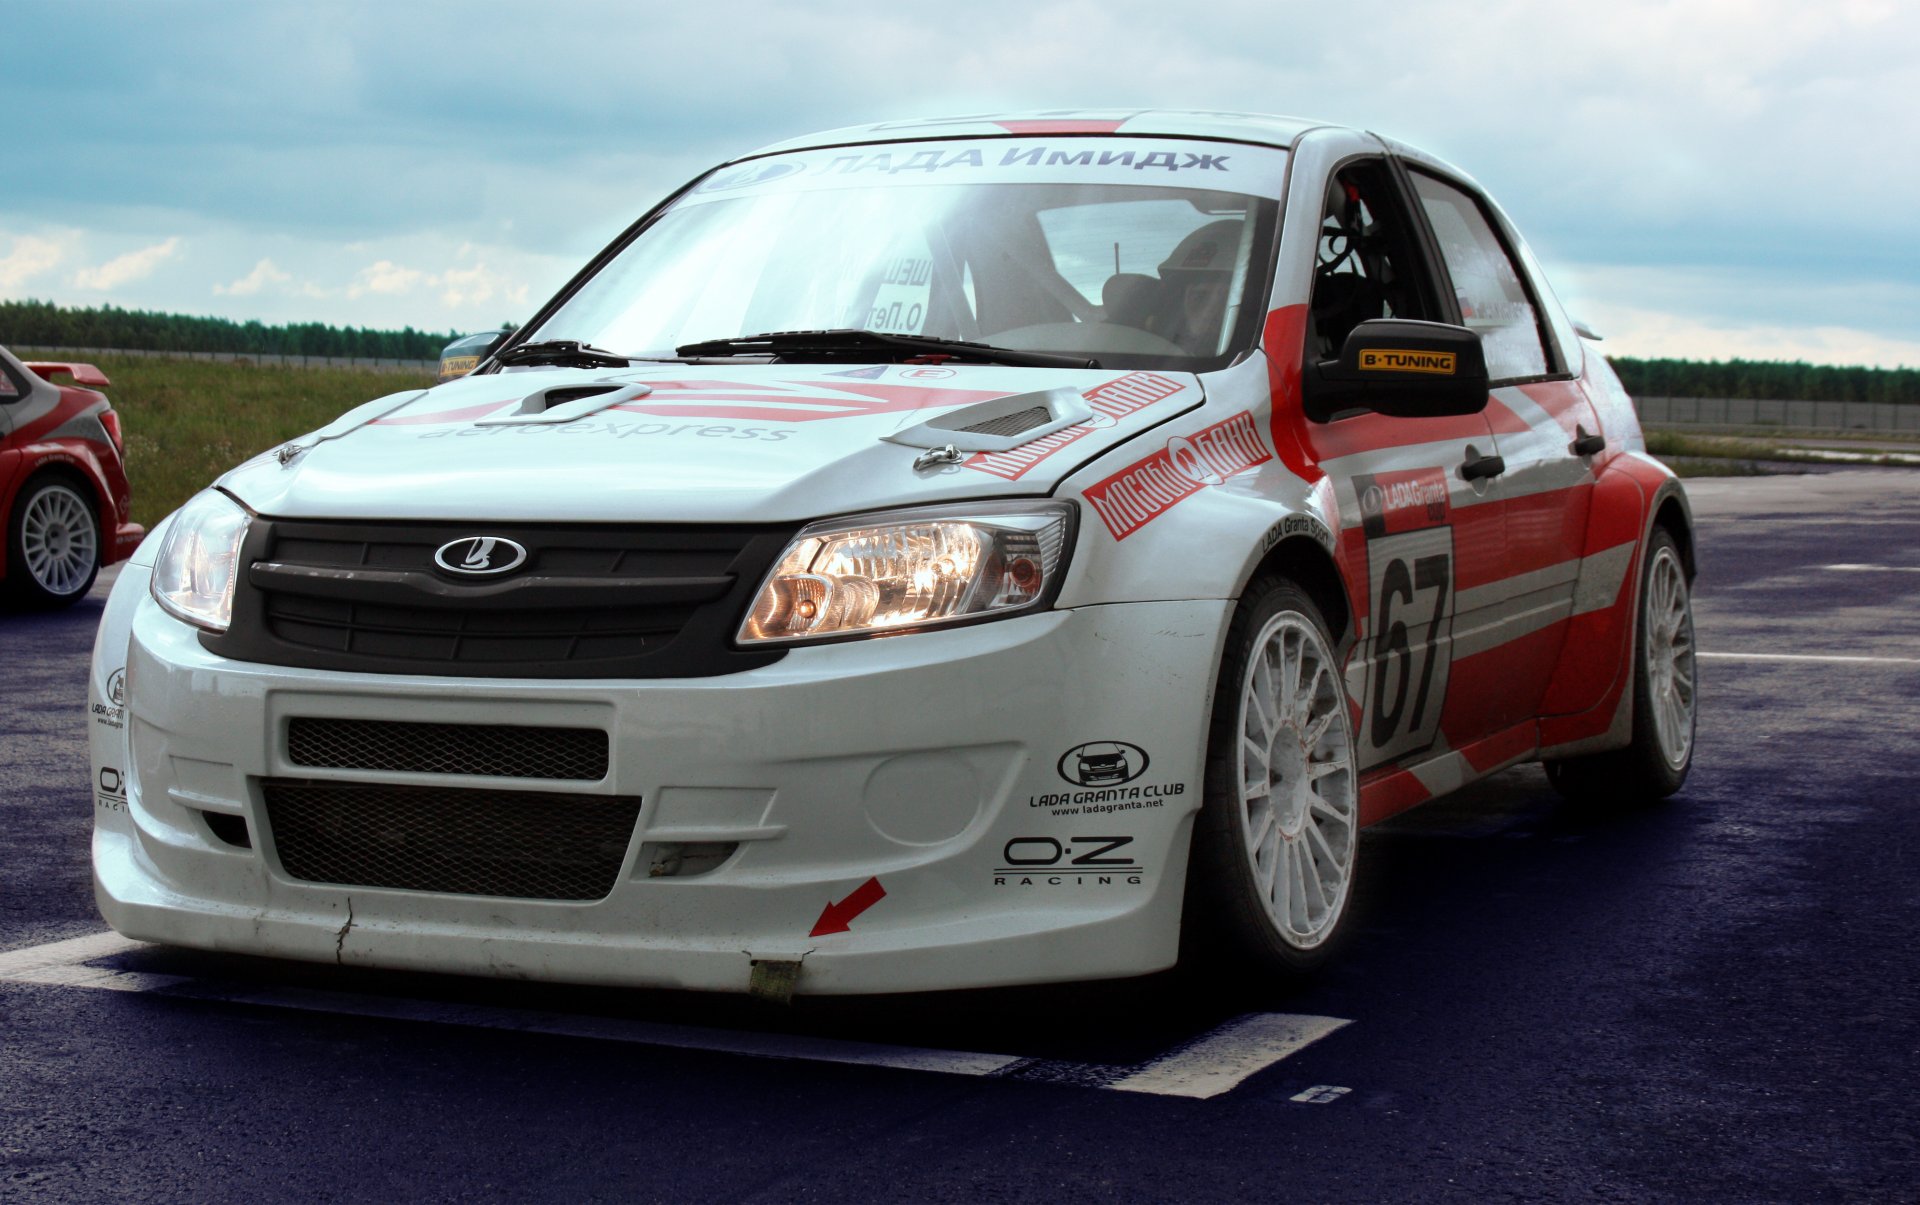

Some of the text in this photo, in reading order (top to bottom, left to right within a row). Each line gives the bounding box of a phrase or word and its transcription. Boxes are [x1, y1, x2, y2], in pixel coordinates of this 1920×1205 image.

[811, 147, 1231, 176] ЛАДА Имидж
[1262, 522, 1283, 553] LADA
[1284, 516, 1309, 533] Granta
[1371, 553, 1449, 748] 67
[1029, 783, 1185, 808] LADA GRANTA CLUB
[994, 876, 1142, 886] RACING
